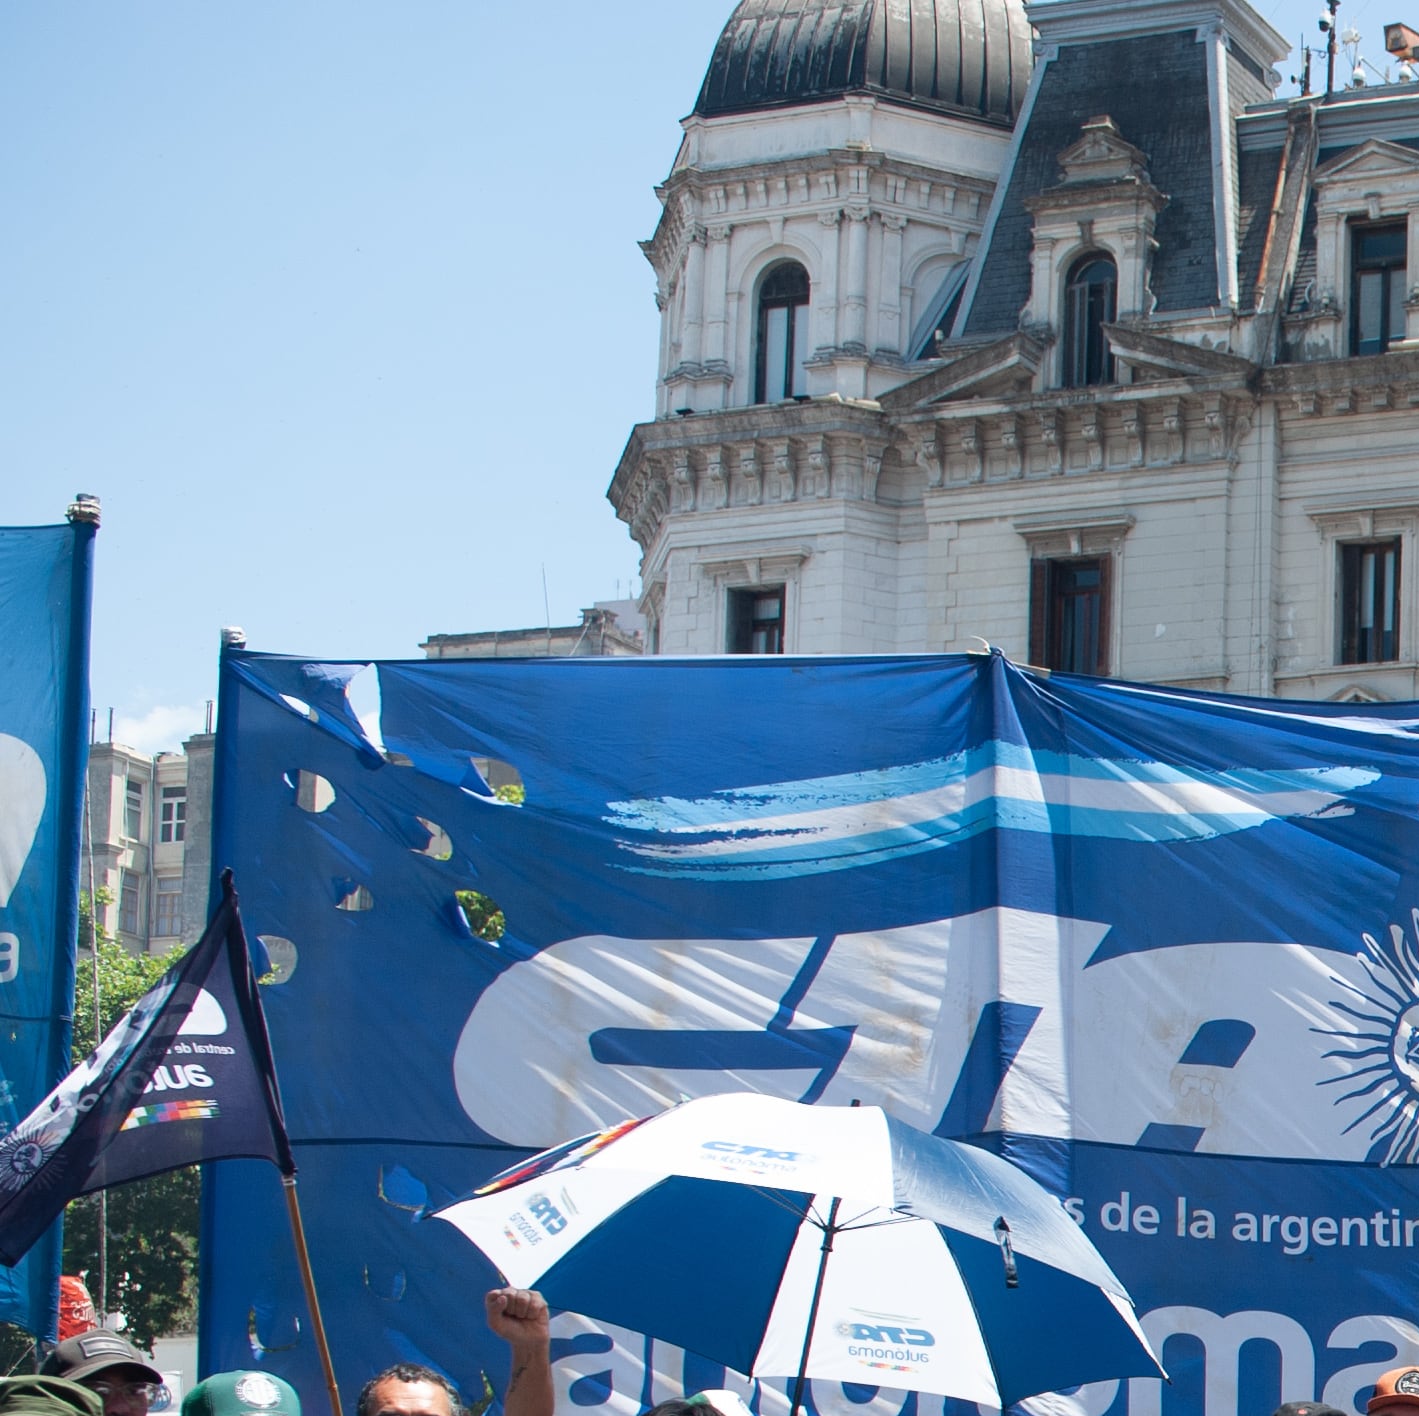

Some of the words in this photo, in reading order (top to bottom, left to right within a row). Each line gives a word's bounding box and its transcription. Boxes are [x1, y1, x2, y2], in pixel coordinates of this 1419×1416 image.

[702, 1140, 802, 1162] CTA
[1101, 1192, 1160, 1236] de
[1176, 1196, 1216, 1240] la
